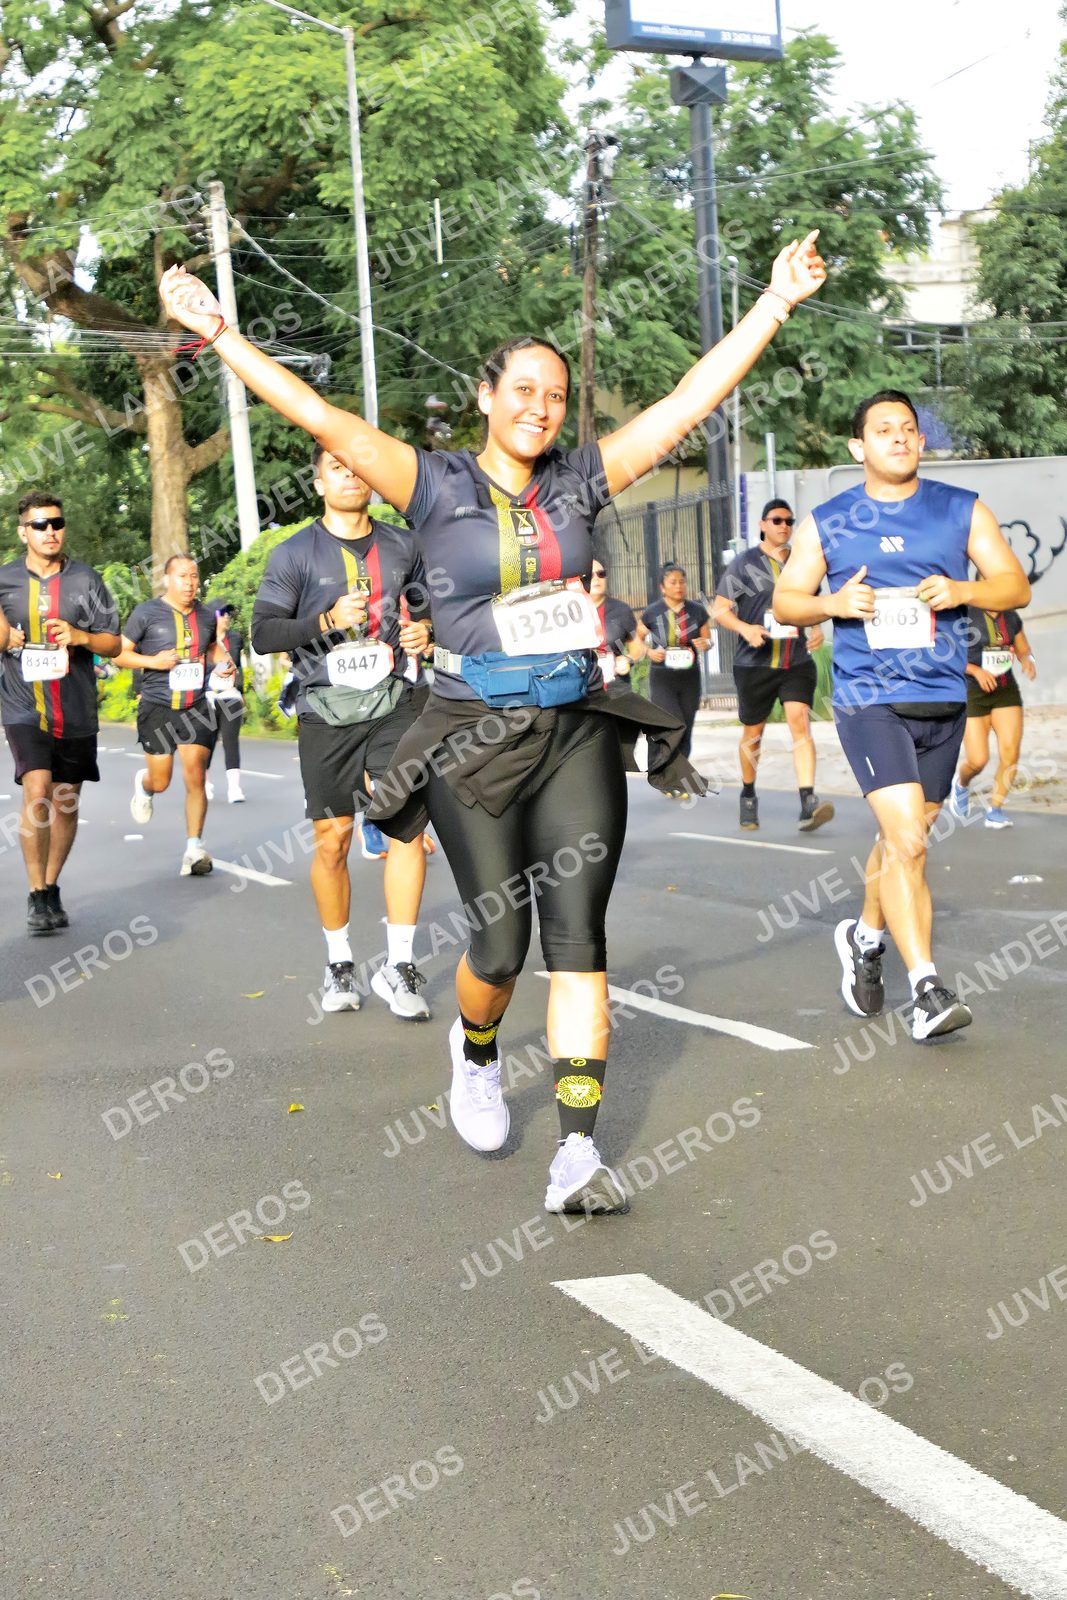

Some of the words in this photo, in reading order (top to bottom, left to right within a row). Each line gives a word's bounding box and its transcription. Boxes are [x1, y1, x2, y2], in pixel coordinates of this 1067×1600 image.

[507, 599, 583, 641] 13260
[872, 608, 919, 627] 8663
[337, 654, 378, 674] 8447
